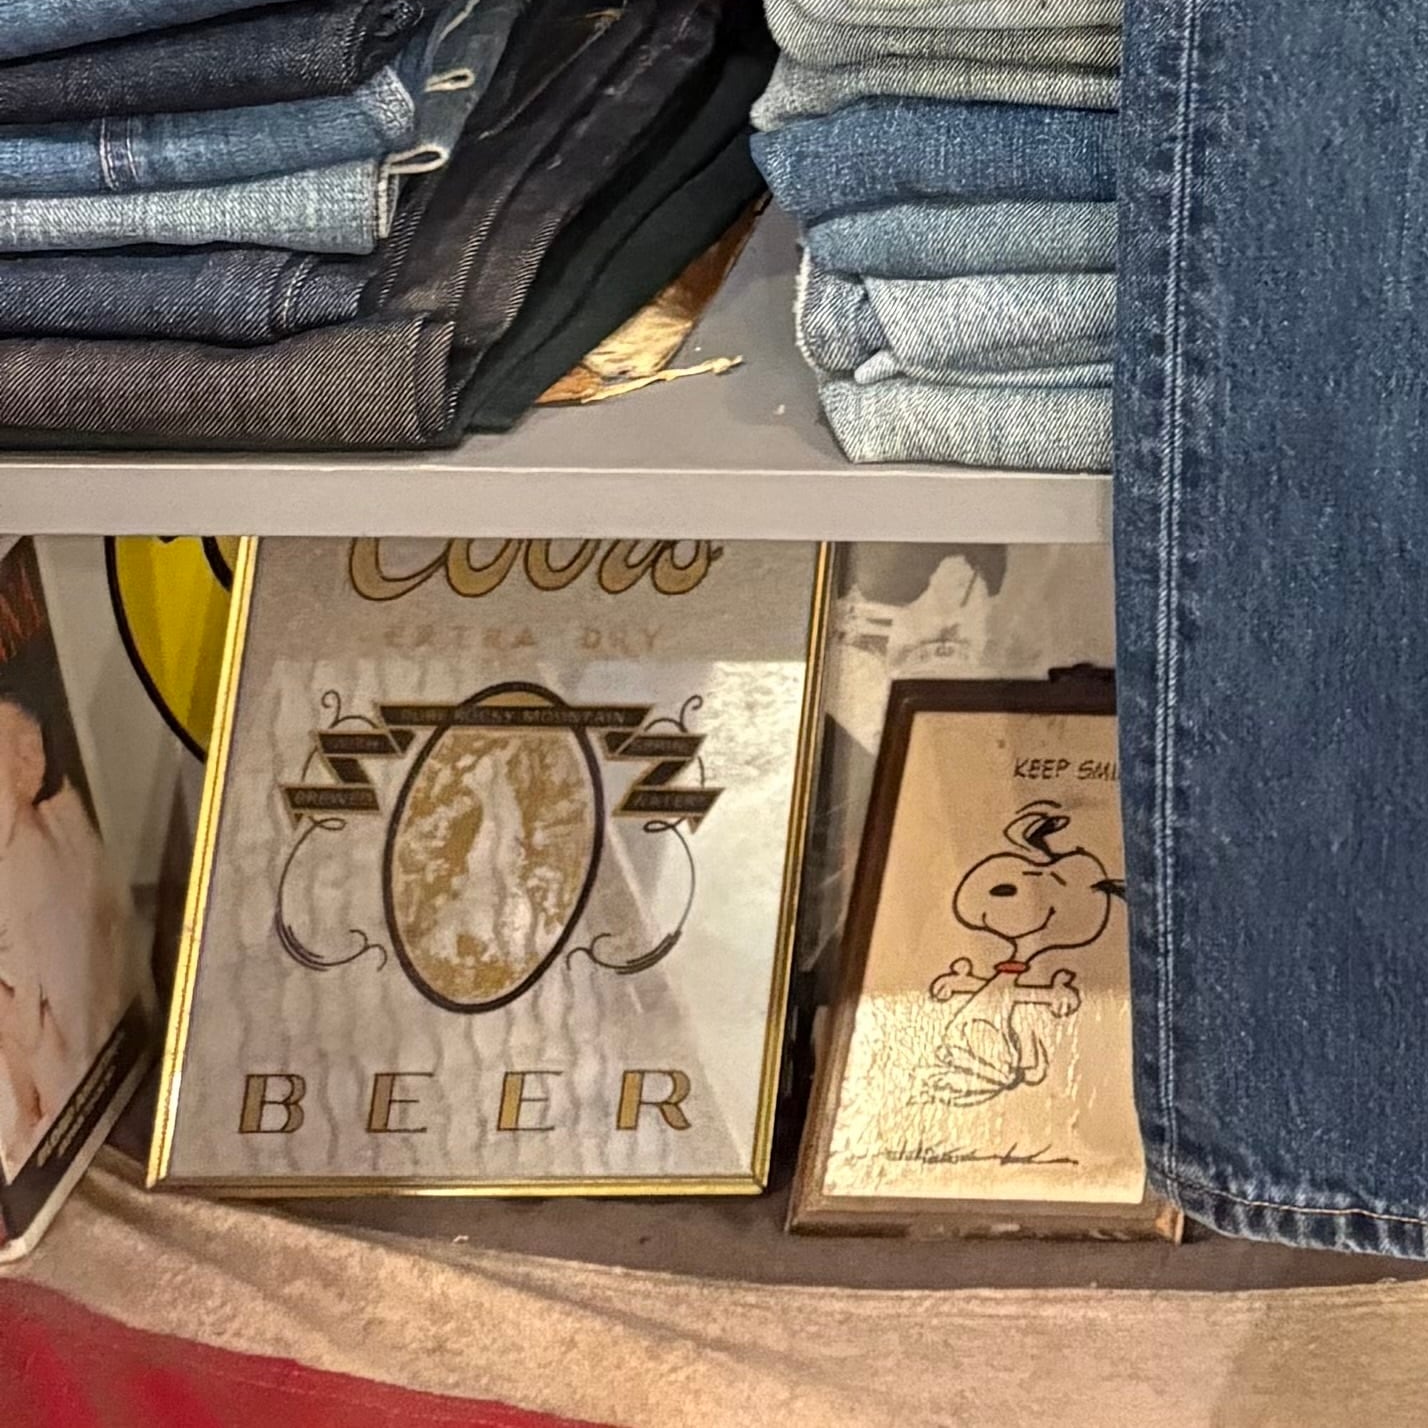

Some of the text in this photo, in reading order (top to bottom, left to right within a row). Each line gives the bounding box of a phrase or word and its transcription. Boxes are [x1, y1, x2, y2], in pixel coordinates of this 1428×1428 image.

[522, 711, 626, 725] MOUNTAIN
[1014, 757, 1071, 780] KEEP
[238, 1070, 692, 1134] BEER
